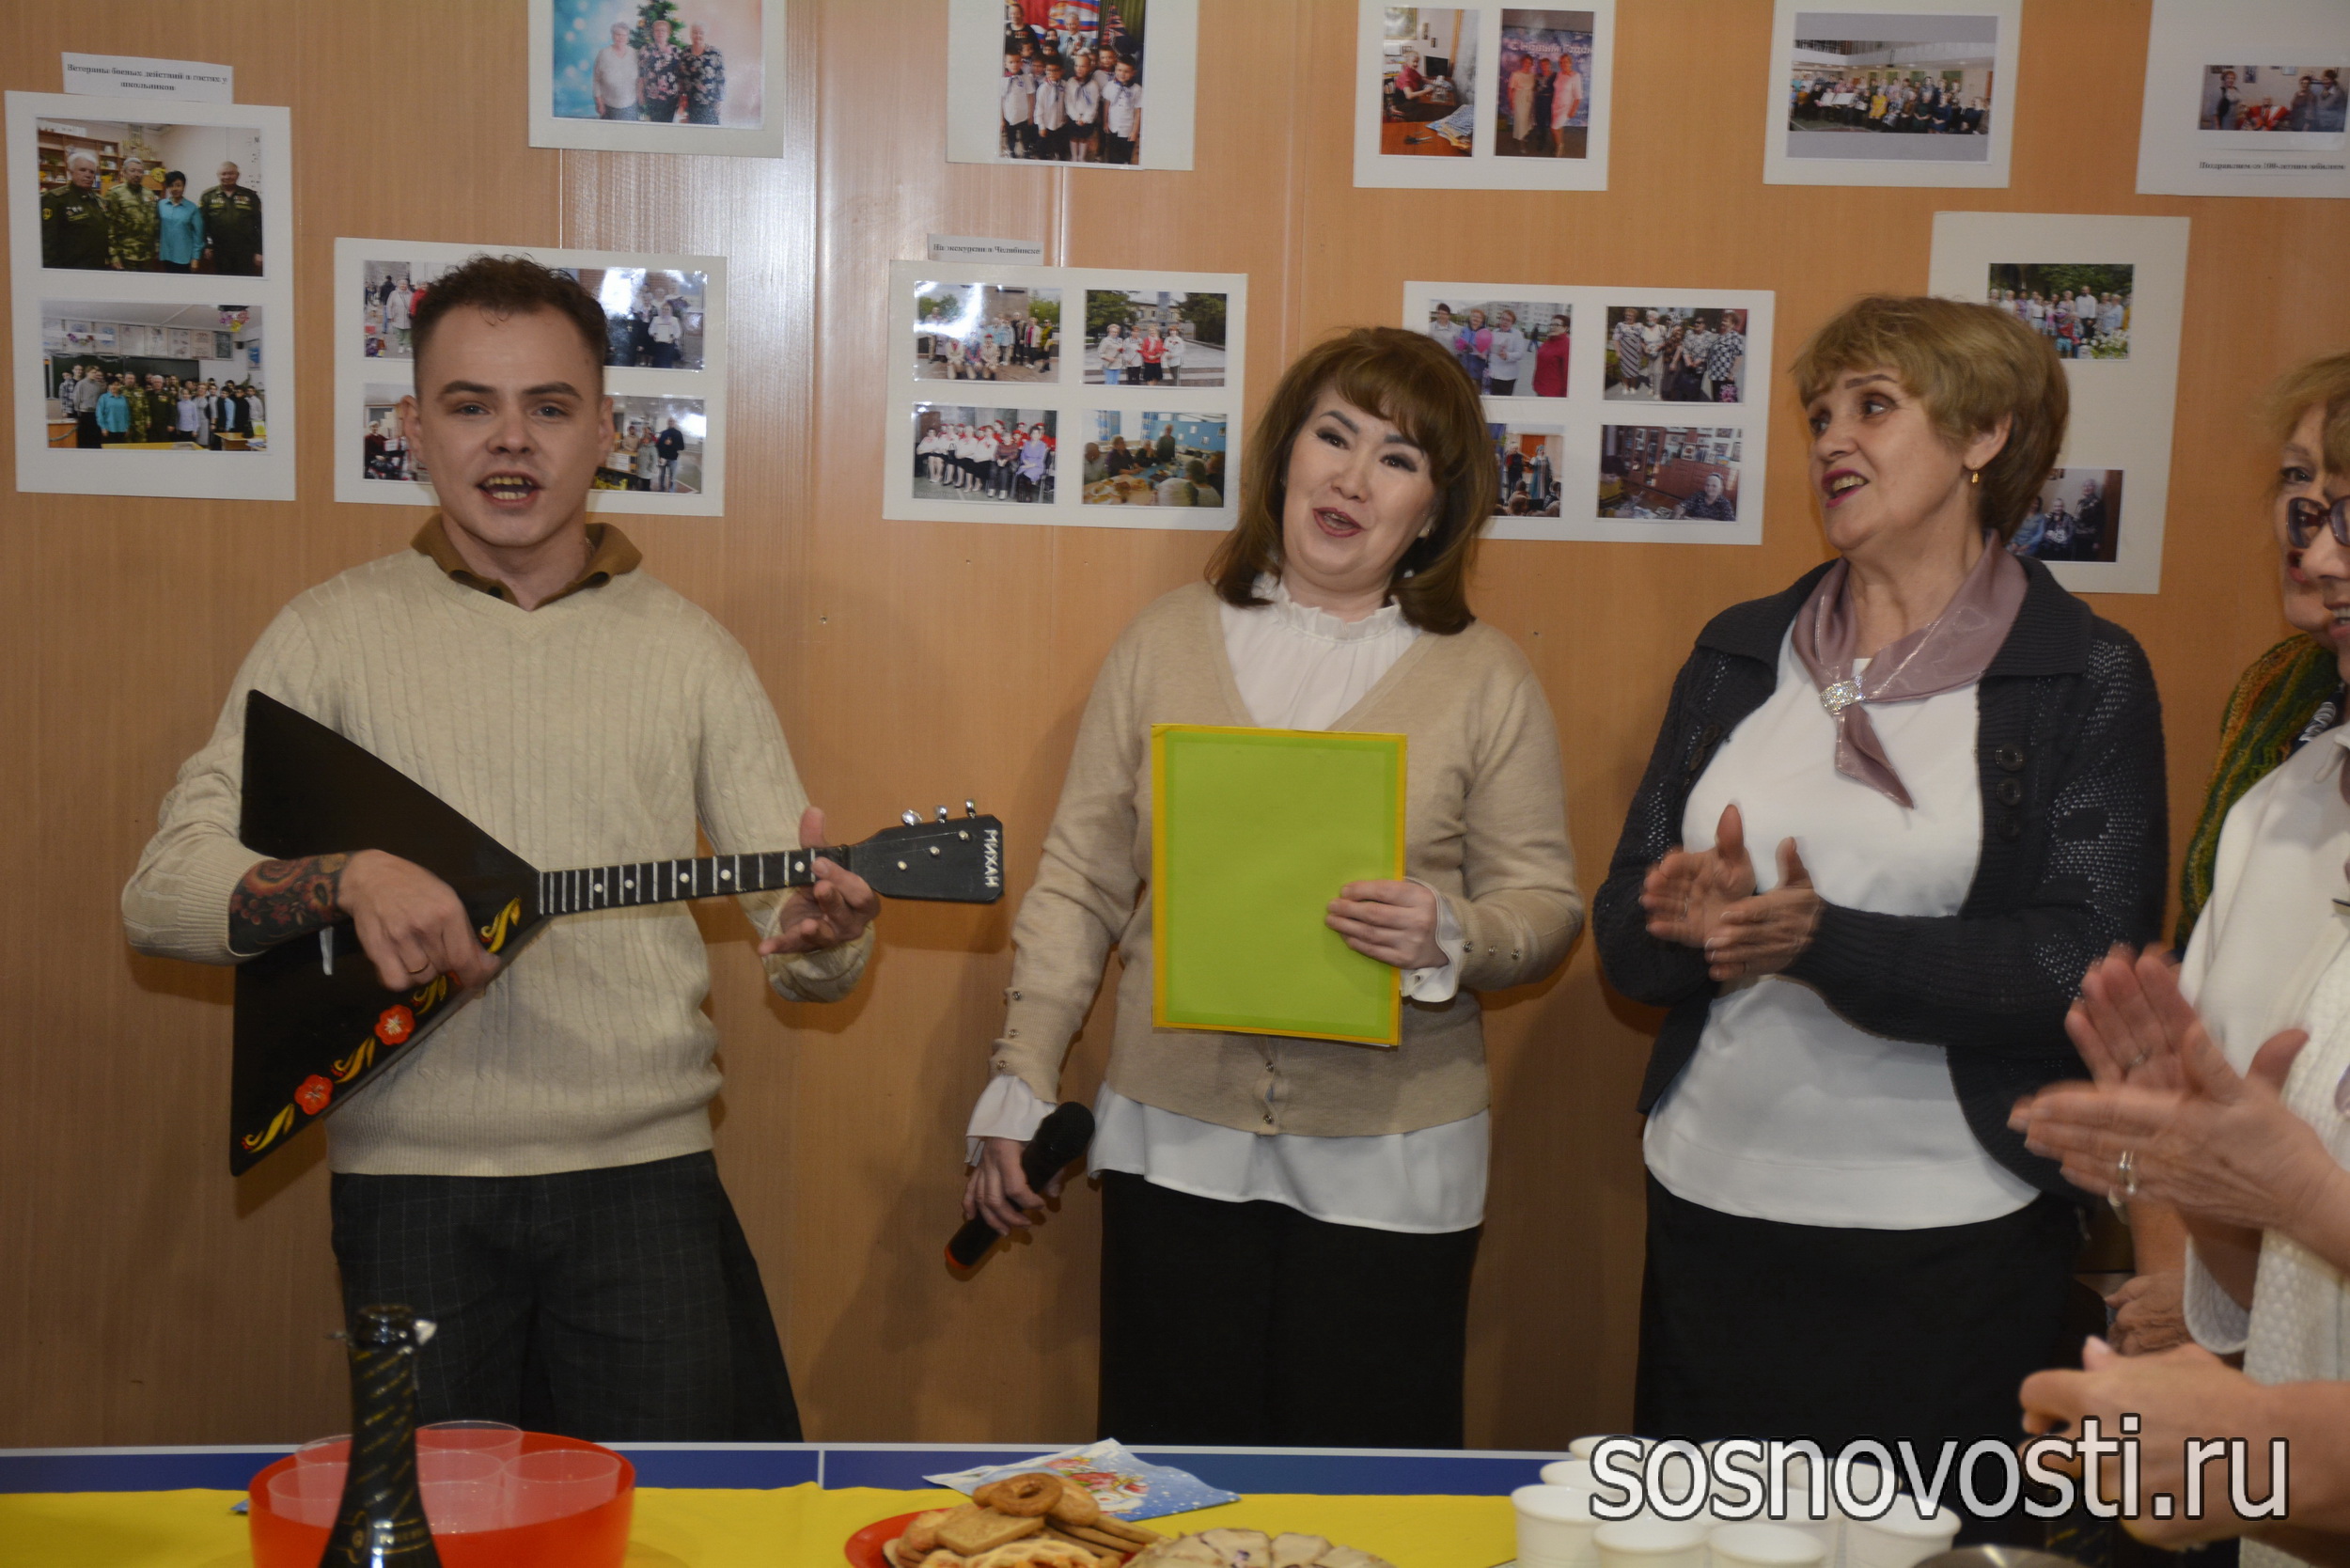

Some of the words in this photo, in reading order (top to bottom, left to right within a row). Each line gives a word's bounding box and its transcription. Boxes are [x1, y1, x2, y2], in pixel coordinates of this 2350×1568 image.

[67, 64, 109, 74] Ветераны
[111, 68, 142, 77] боевых
[145, 71, 183, 80] действий
[120, 82, 177, 91] школьников
[994, 245, 1041, 255] Челябинске
